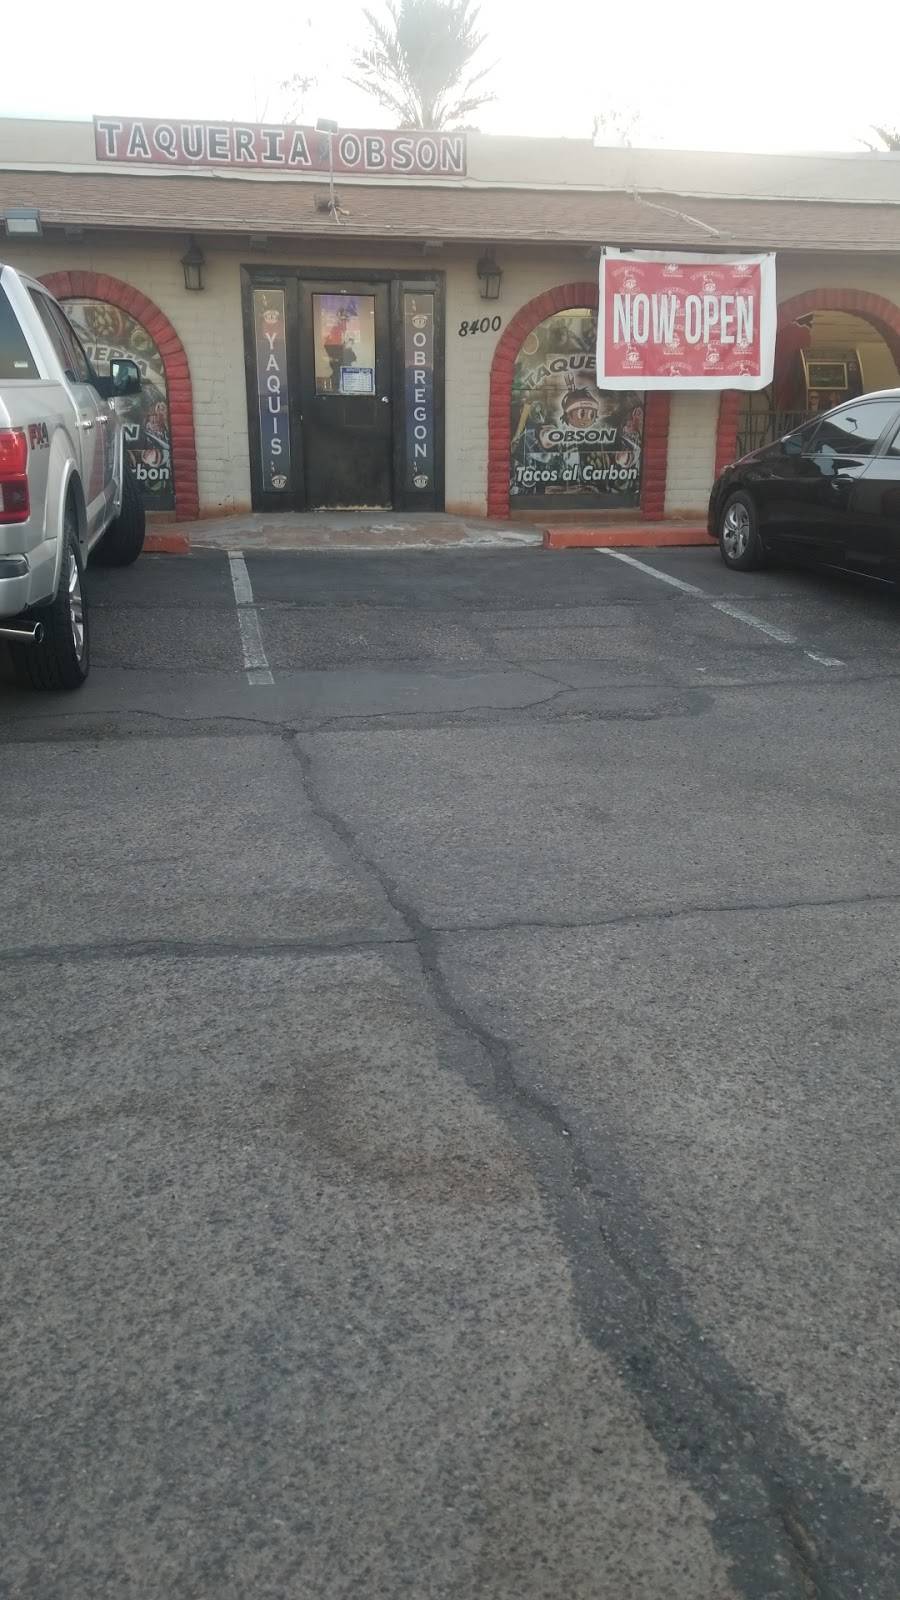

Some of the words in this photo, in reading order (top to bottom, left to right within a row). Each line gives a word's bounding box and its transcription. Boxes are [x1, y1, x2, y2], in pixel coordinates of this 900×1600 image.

[97, 121, 312, 167] TAQUERIA
[339, 133, 464, 172] OBSON
[458, 316, 501, 336] 8400
[613, 293, 677, 344] NOW
[685, 295, 753, 344] OPEN
[265, 332, 282, 455] YAQUIS
[412, 332, 427, 457] OBREGON
[548, 430, 617, 444] OBSON
[515, 466, 558, 482] Tacos
[562, 465, 578, 481] al
[582, 465, 638, 481] Carbon
